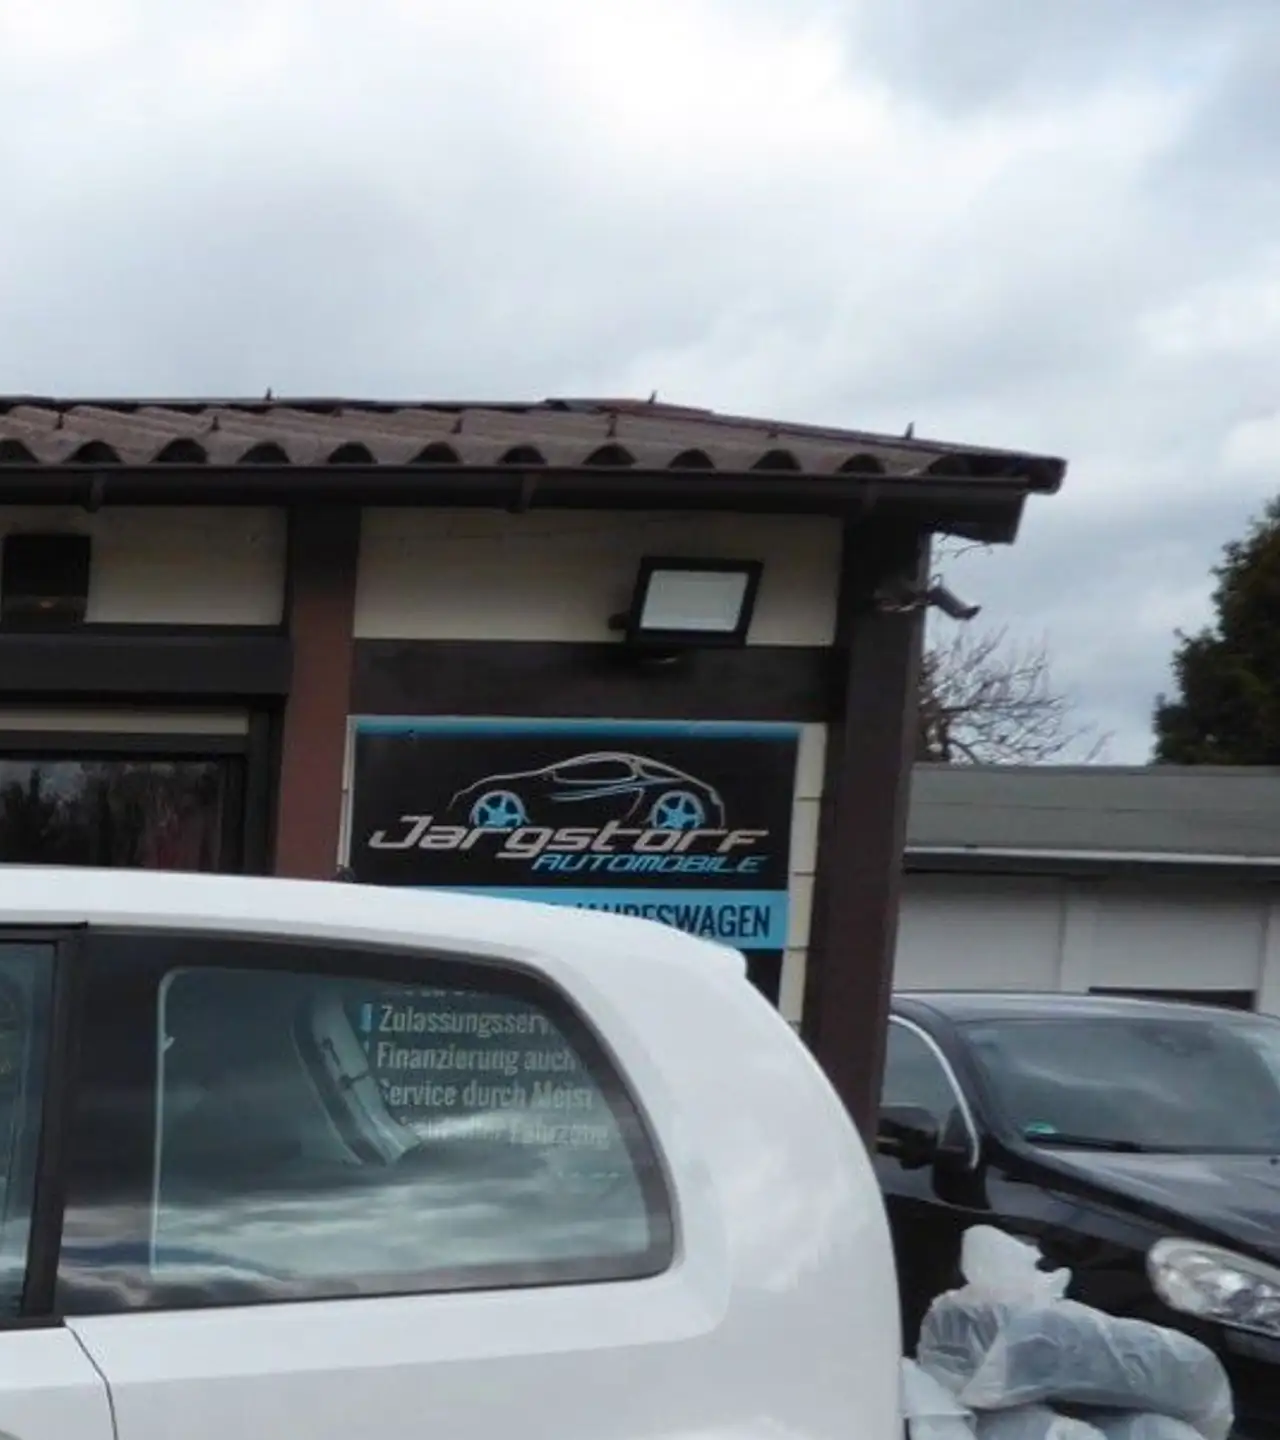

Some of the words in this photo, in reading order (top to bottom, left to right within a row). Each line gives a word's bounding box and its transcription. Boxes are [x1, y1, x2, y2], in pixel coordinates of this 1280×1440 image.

[532, 853, 768, 873] AUTOMOBILE
[574, 902, 771, 939] SWAGEN
[378, 1003, 553, 1038] Zulassungsserv
[376, 1042, 518, 1076] Finanzierung
[524, 1046, 576, 1074] auch
[462, 1079, 527, 1109] durch
